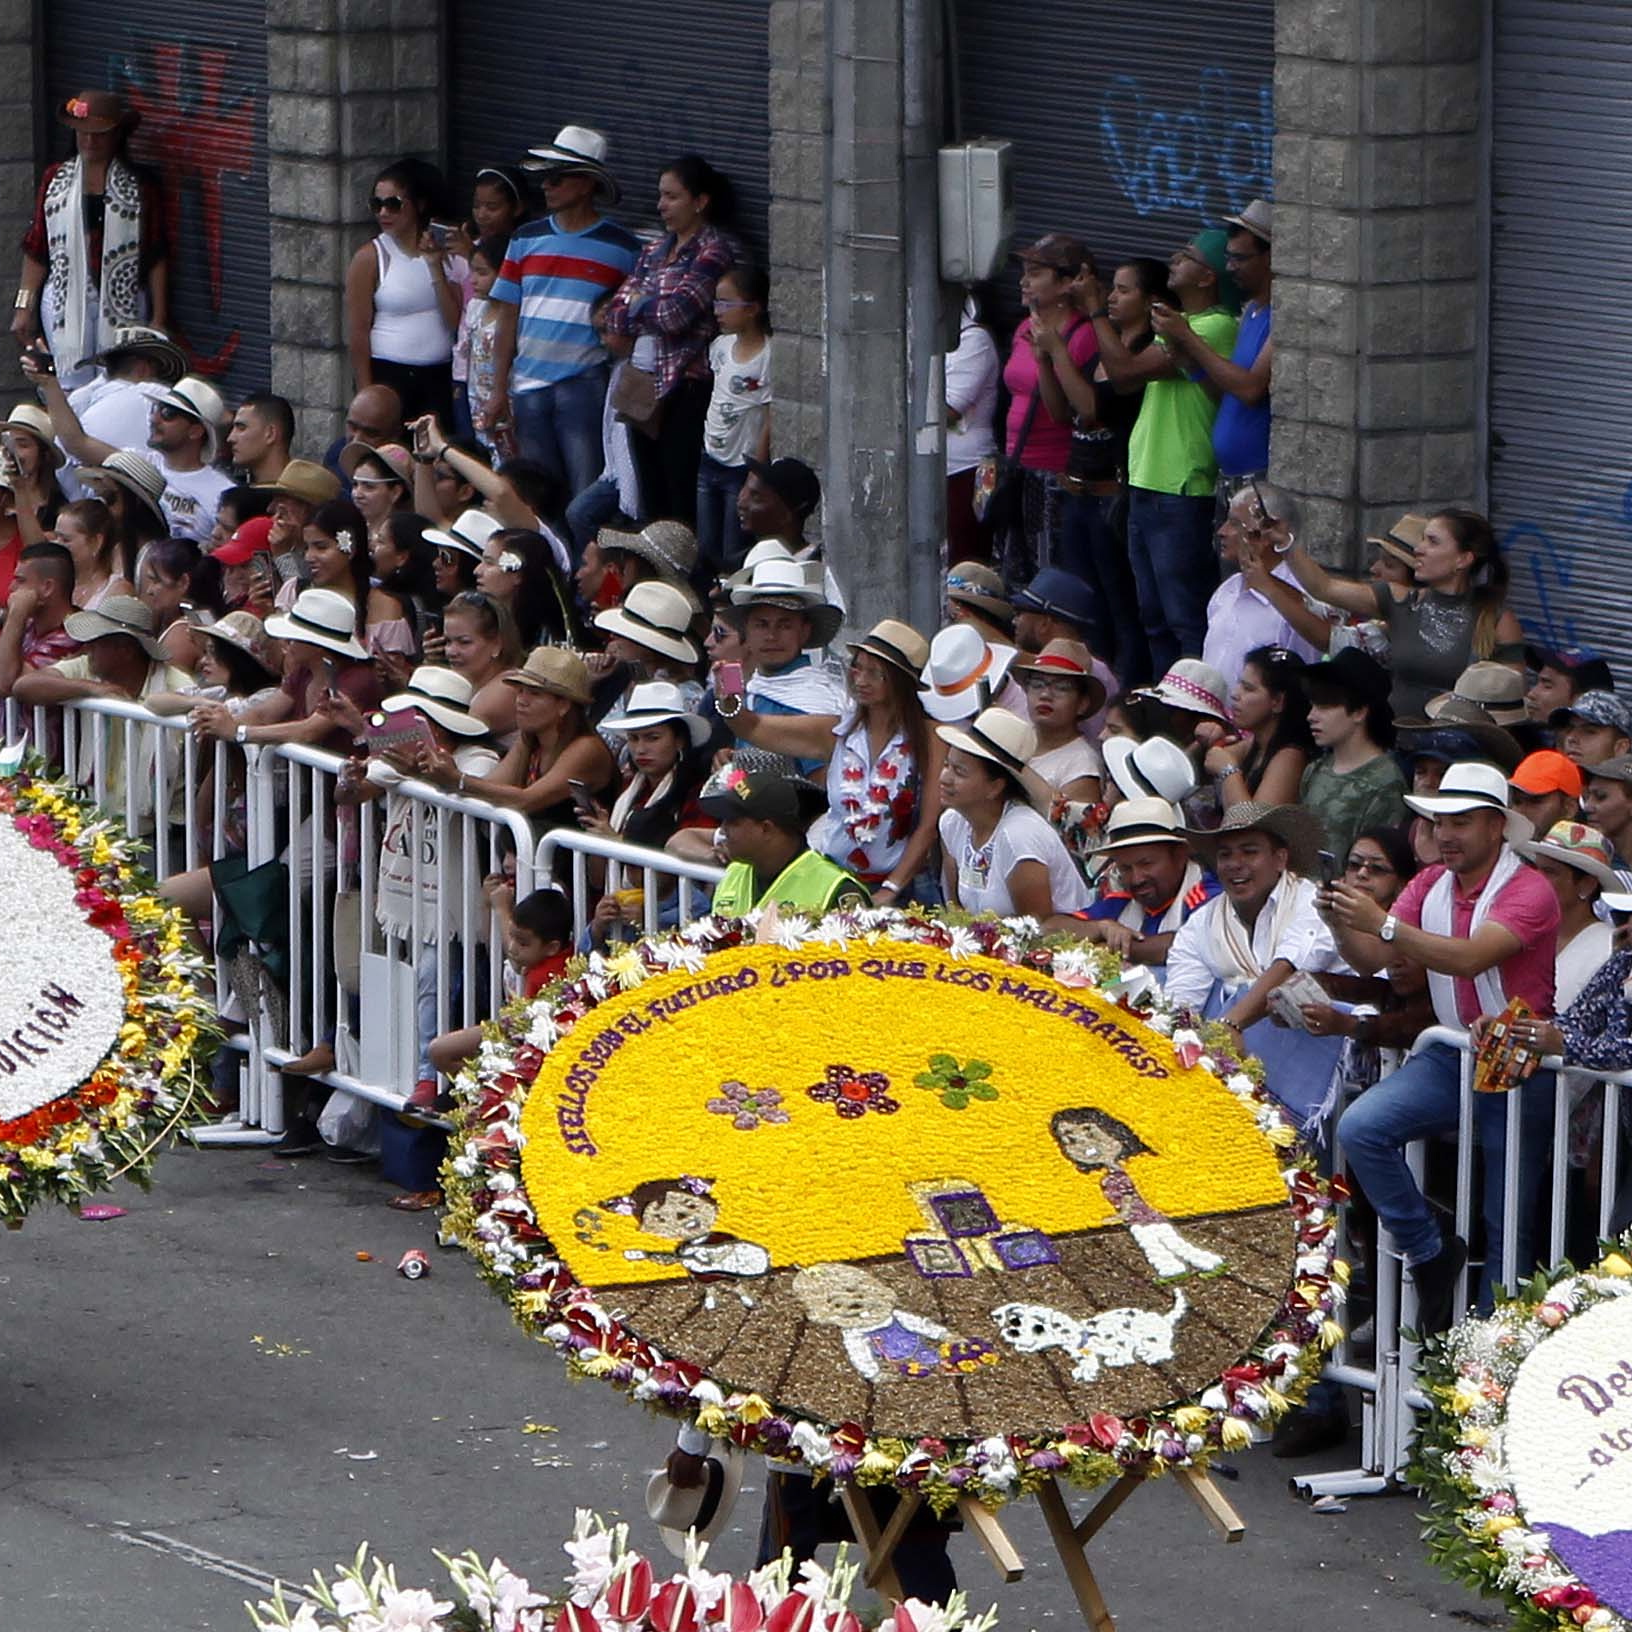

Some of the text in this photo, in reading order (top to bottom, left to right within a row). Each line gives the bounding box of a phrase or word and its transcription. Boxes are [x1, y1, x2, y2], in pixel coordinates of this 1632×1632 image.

[615, 1012, 653, 1035] EL
[645, 967, 759, 1023] FUTURO
[770, 958, 852, 988] ¿POR
[858, 959, 928, 981] QUE
[933, 962, 994, 993] LOS
[997, 976, 1169, 1080] MALTRATAS?
